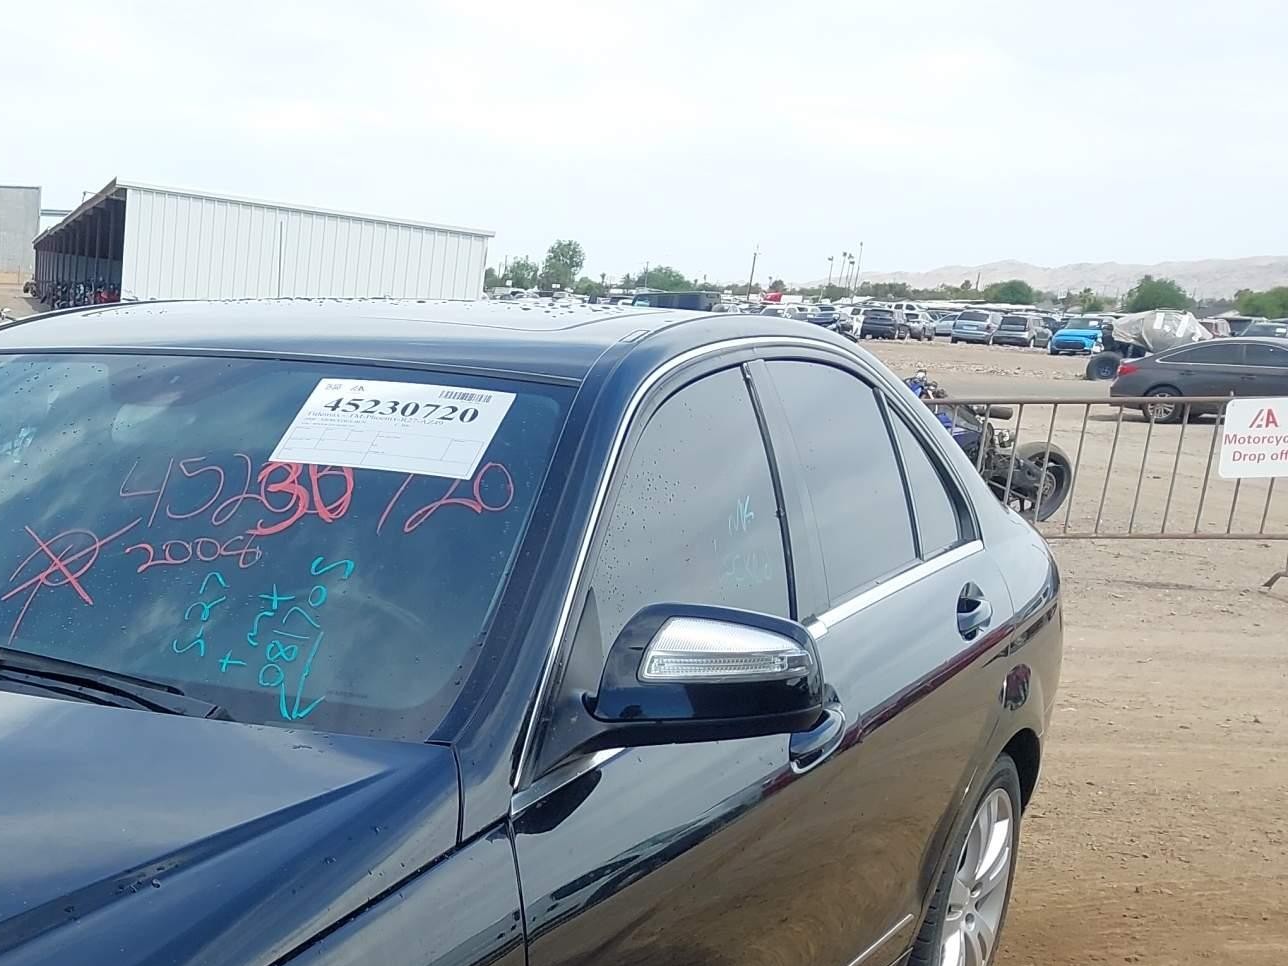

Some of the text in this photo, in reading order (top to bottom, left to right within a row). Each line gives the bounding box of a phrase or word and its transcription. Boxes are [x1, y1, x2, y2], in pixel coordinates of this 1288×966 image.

[324, 397, 479, 423] 45230720
[1232, 449, 1288, 464] Drop off
